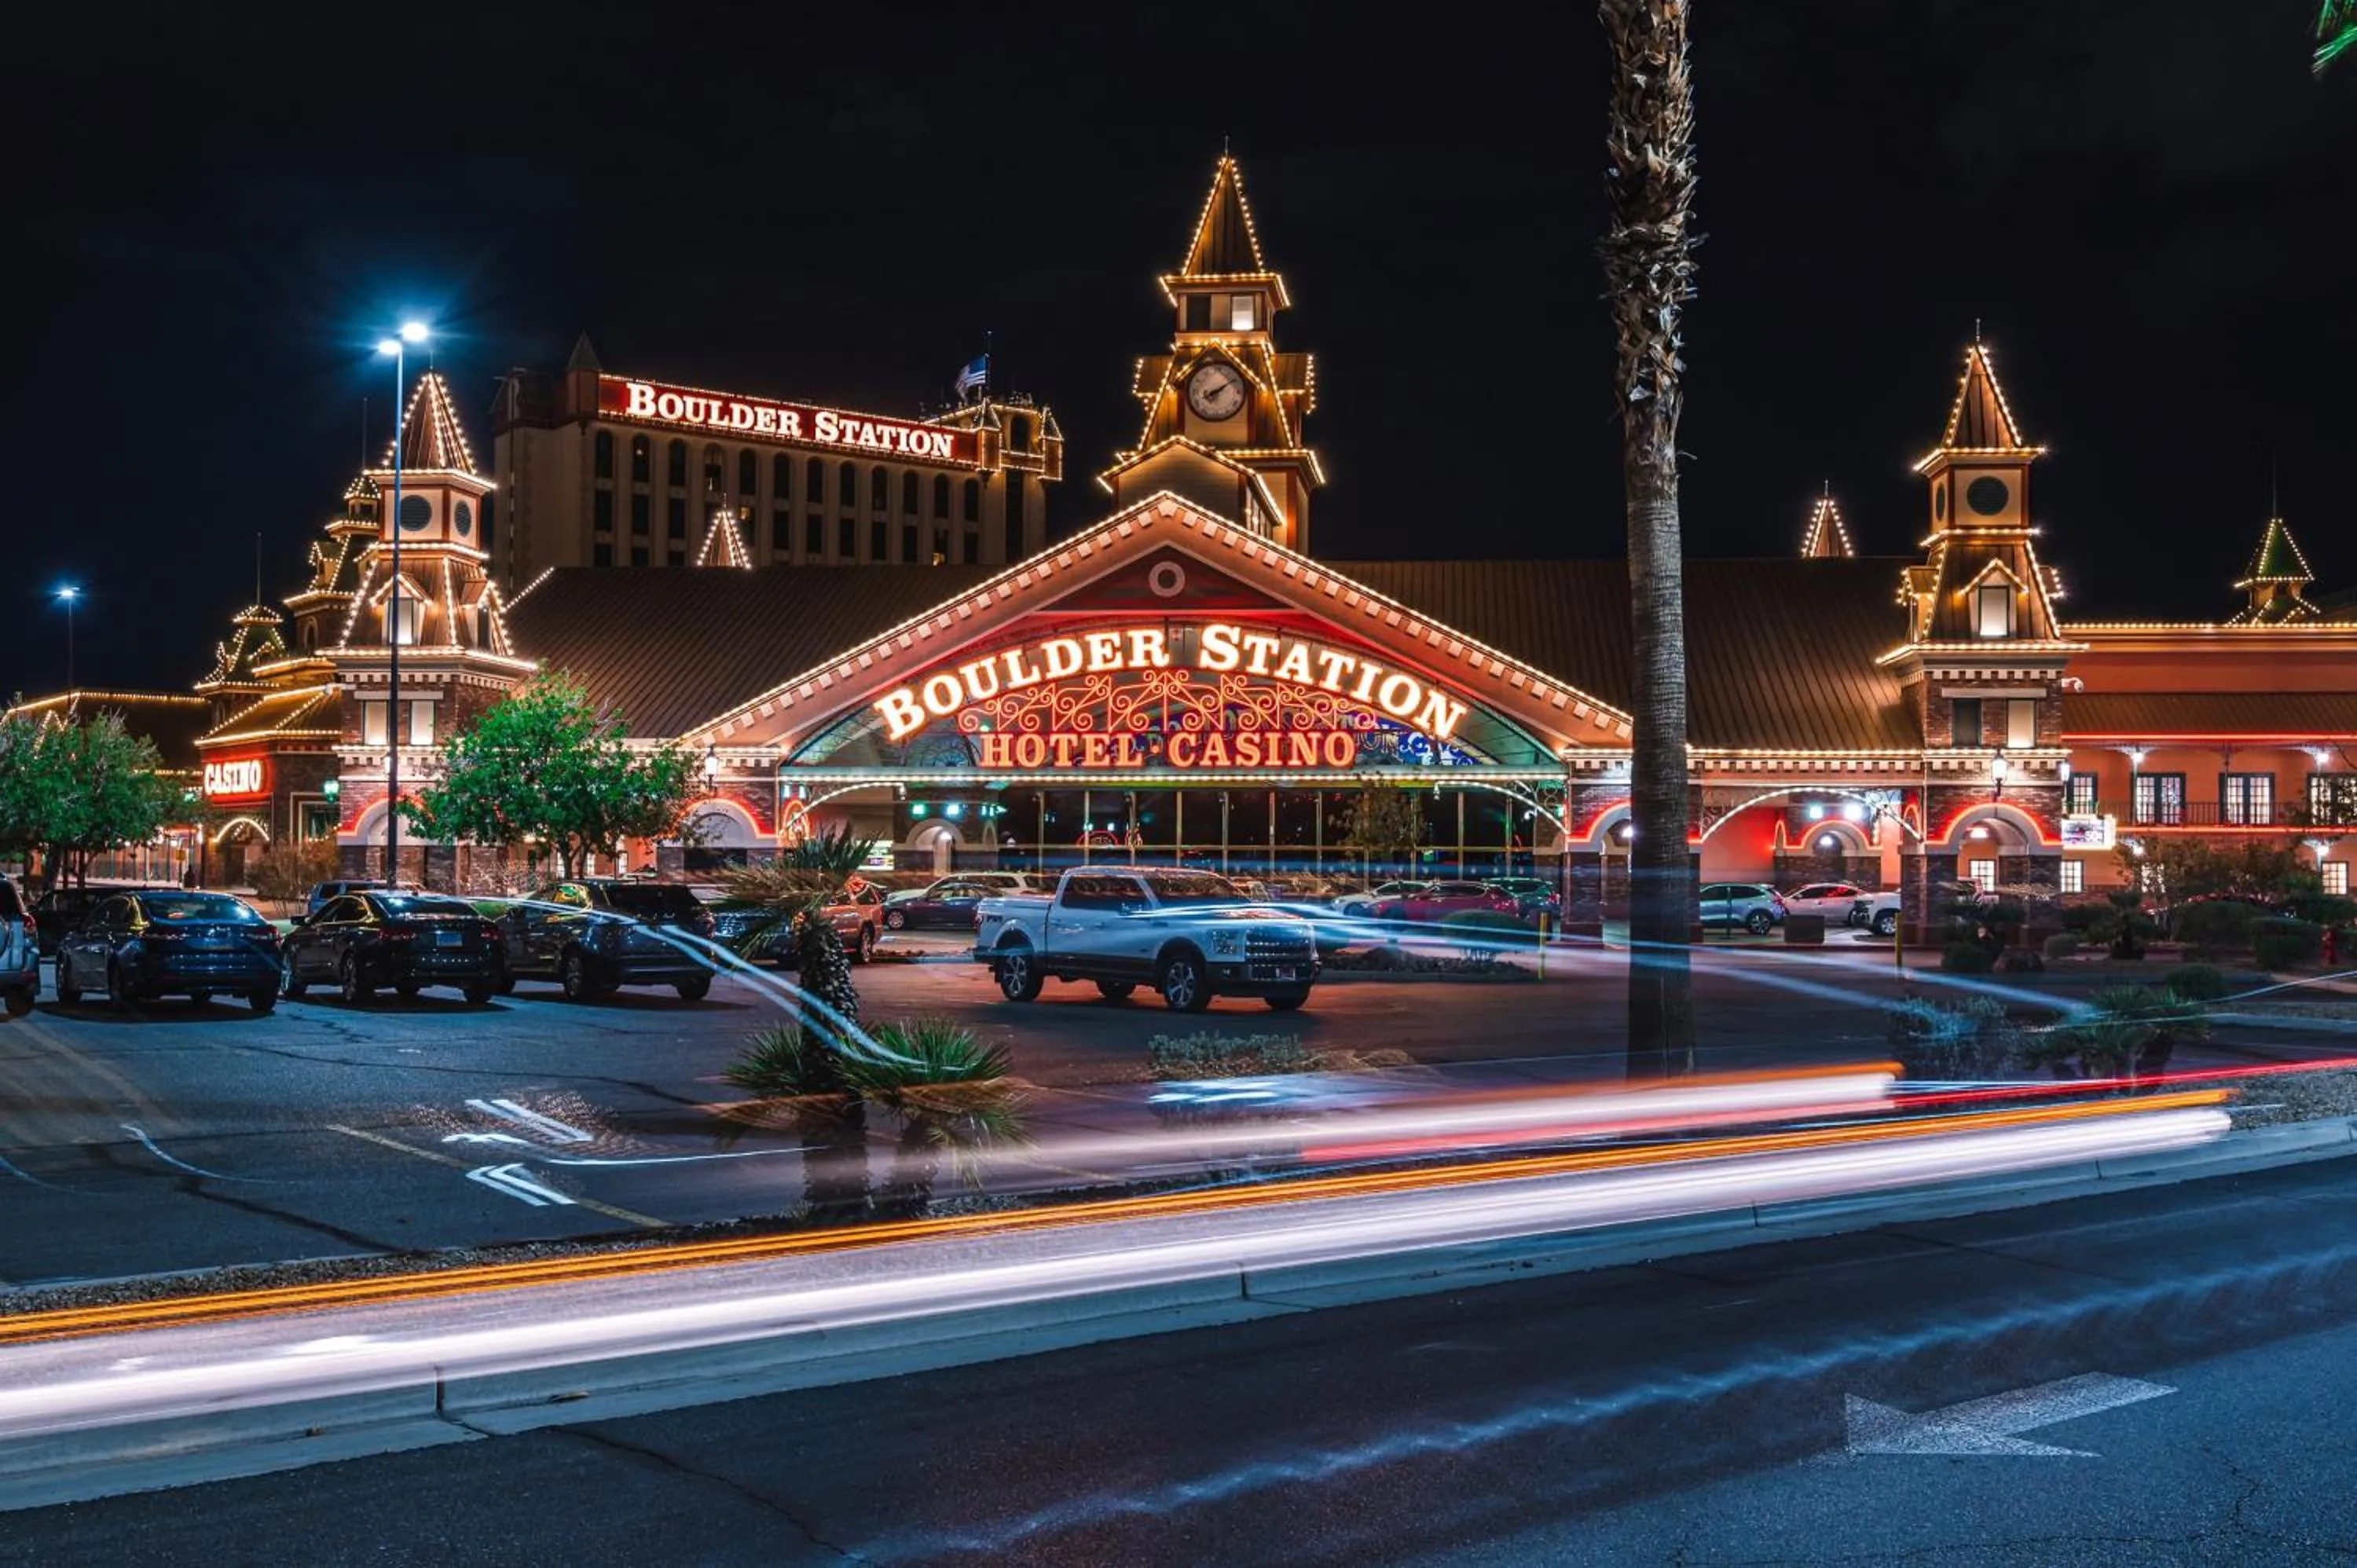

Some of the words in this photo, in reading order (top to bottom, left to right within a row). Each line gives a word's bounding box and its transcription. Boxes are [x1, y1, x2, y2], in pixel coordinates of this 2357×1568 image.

[625, 382, 802, 438] BOULDER
[814, 410, 955, 457] STATION
[873, 628, 1170, 741] BOULDER
[1199, 623, 1468, 738] STATION
[204, 759, 262, 795] CASINO
[979, 732, 1144, 768] HOTEL
[1168, 731, 1356, 768] CASINO
